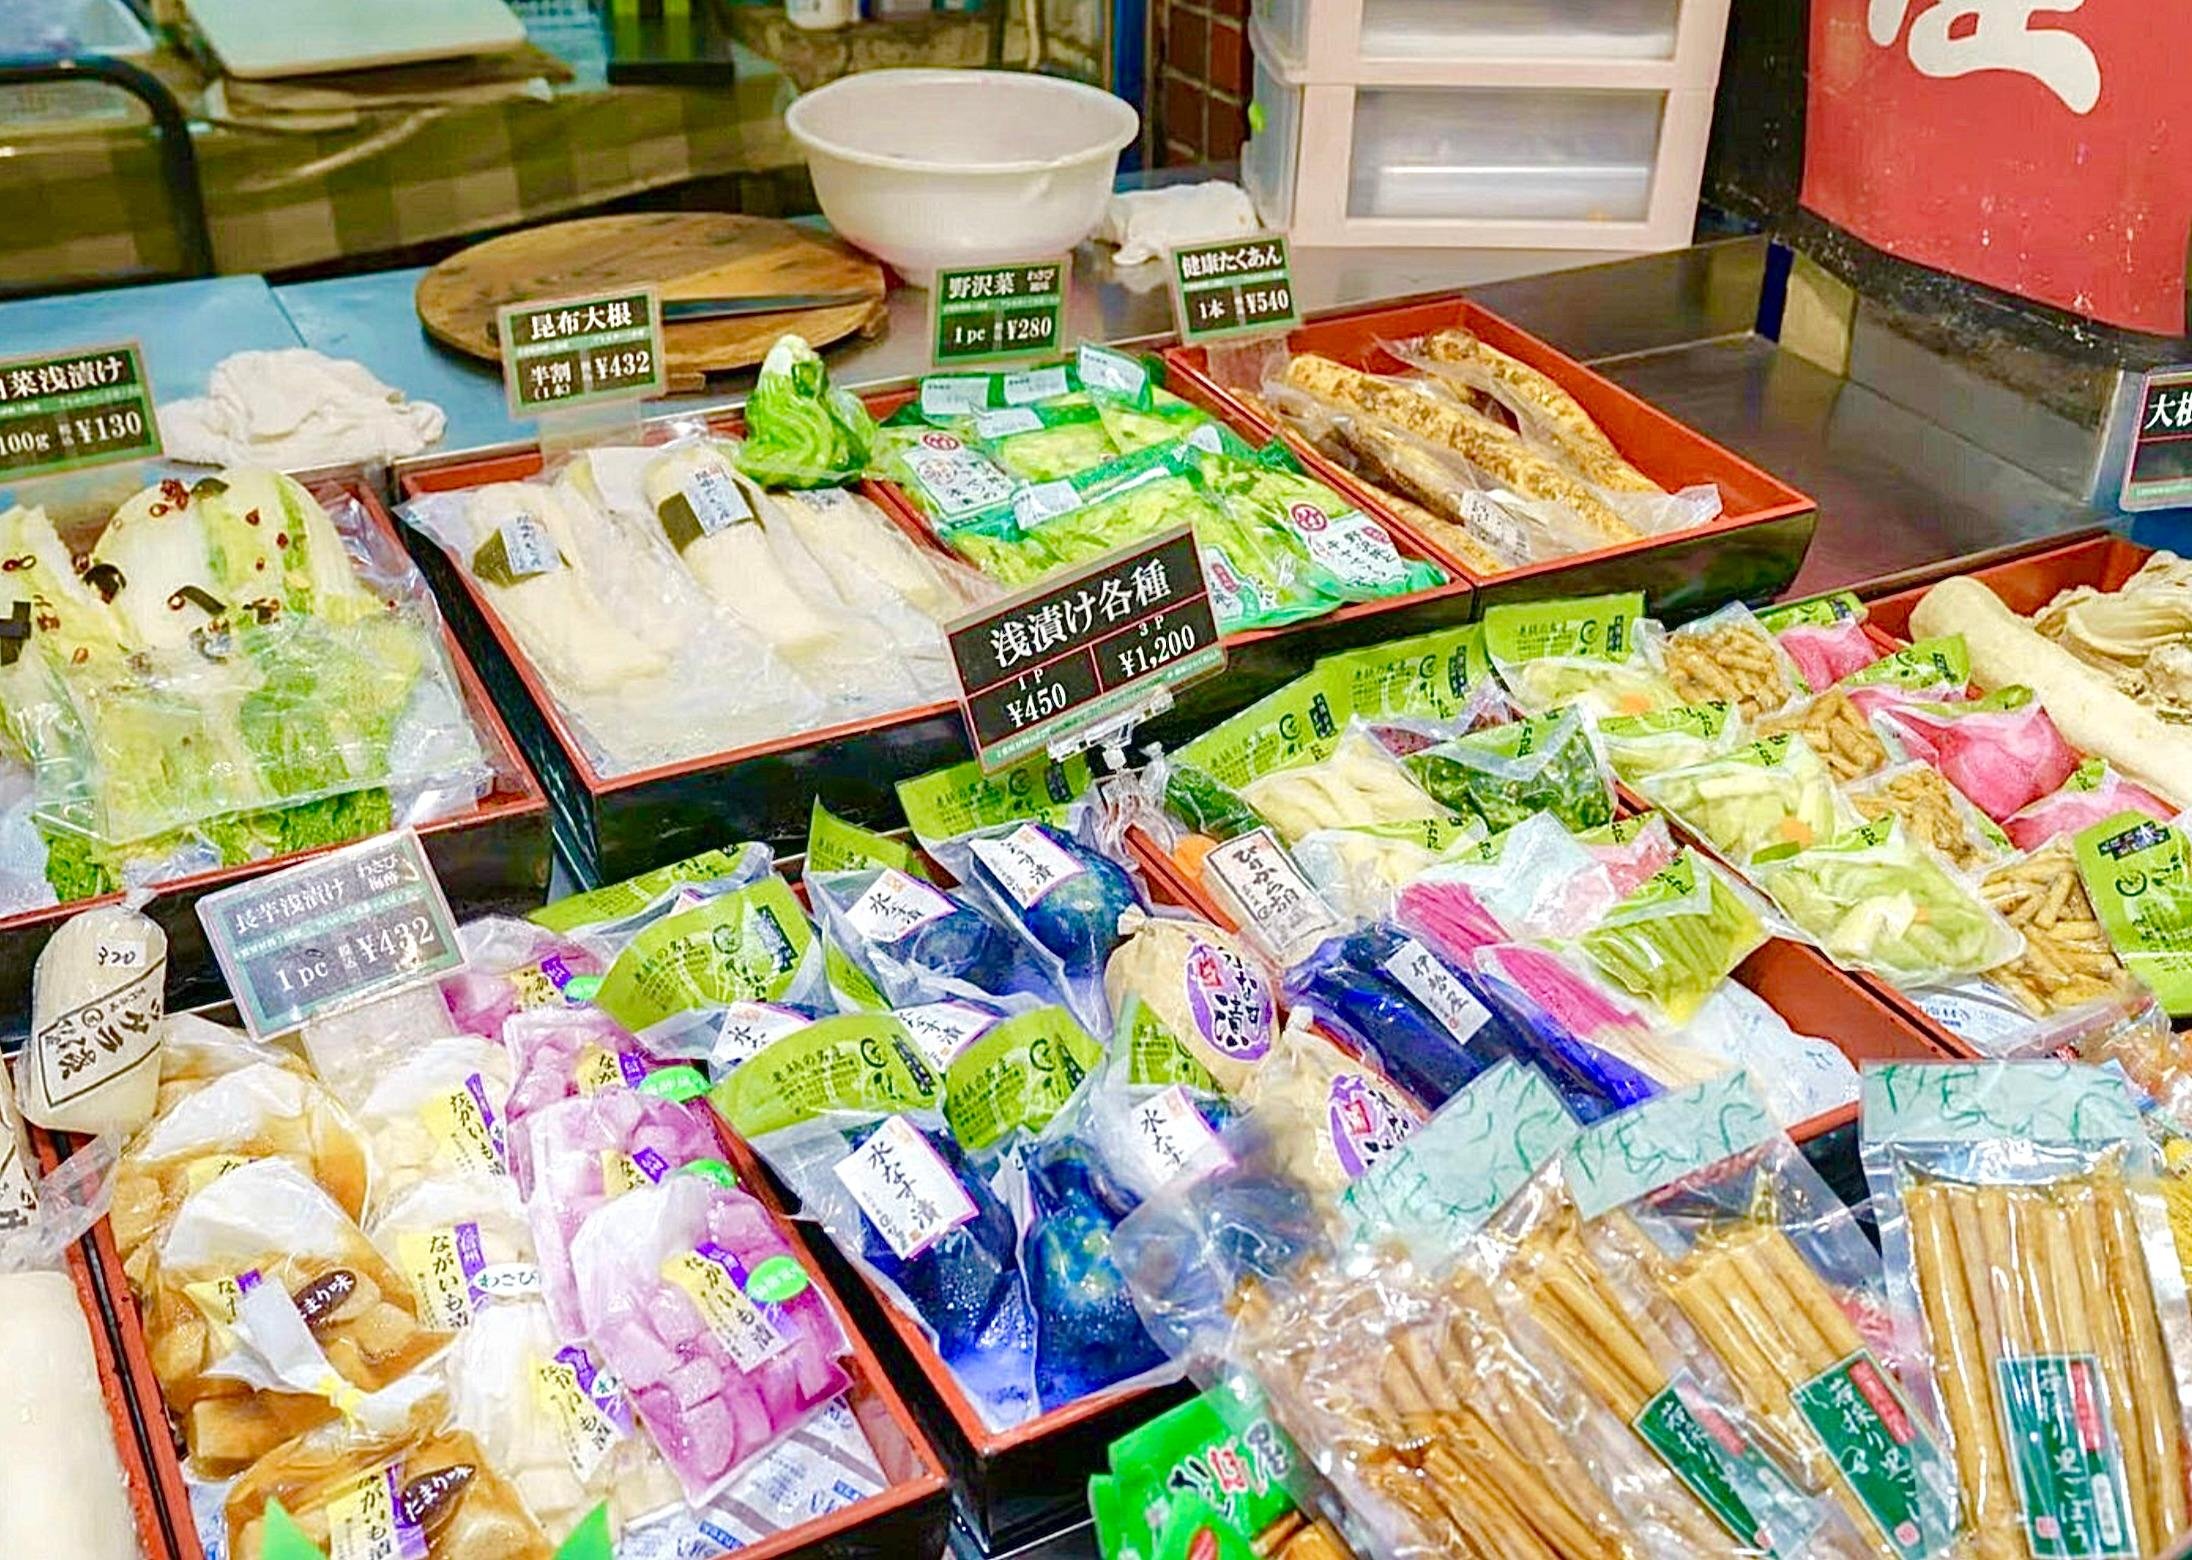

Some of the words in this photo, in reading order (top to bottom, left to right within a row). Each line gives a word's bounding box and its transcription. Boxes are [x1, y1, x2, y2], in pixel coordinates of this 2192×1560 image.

[1181, 244, 1283, 279] 健康たくあん
[948, 271, 1016, 299] 野沢菜
[1244, 288, 1289, 314] ¥540
[530, 302, 633, 340] 昆布大根
[967, 327, 986, 345] pc
[1007, 315, 1052, 340] ¥280
[530, 360, 572, 387] 半割
[594, 350, 650, 380] ¥432
[75, 411, 142, 444] ¥130
[989, 557, 1173, 669] 浅漬け各種
[1117, 624, 1196, 678] ¥1,200
[1006, 682, 1068, 728] ¥450
[235, 876, 346, 935] 長芋浅漬け
[299, 961, 329, 986] pc
[356, 915, 435, 964] ¥432
